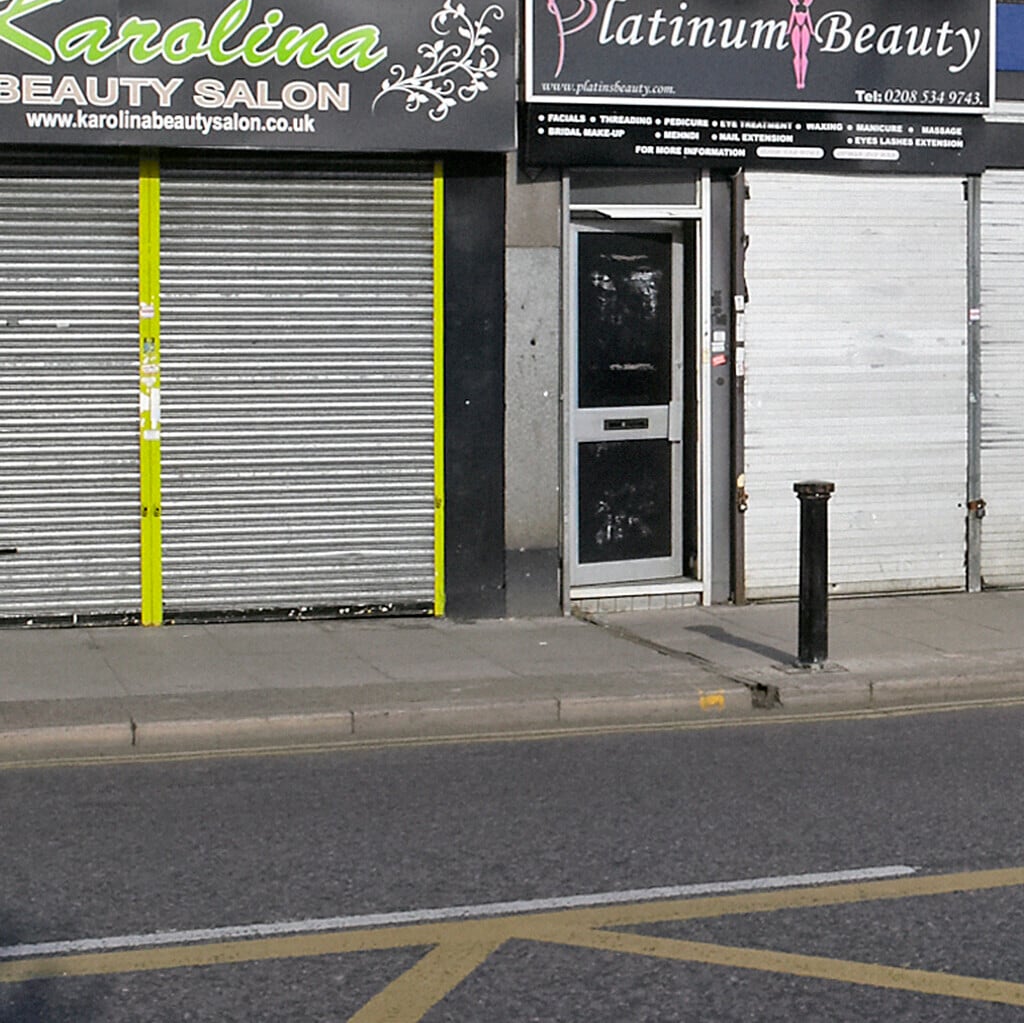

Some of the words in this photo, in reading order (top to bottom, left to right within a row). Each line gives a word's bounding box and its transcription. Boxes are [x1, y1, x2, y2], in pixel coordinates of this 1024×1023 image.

[815, 11, 982, 73] Beauty
[193, 80, 350, 111] SALON
[855, 89, 882, 103] Tel:
[884, 88, 918, 104] 0208
[920, 90, 945, 105] 534
[26, 110, 316, 135] www.karolinabeautysalon.co.uk
[547, 113, 587, 124] FACIALS
[599, 115, 652, 126] THREADING
[664, 118, 709, 128] PEDICURE
[806, 122, 844, 132] WAXING
[855, 123, 903, 134] MANICURE
[921, 126, 963, 136] MASSAGE
[547, 127, 582, 137] BRIDAL
[583, 129, 625, 139] MAKE-UP
[663, 130, 700, 141] MEHNDI
[719, 132, 740, 142] NAIL
[741, 133, 794, 144] EXTENSION
[854, 136, 878, 146] EYES
[879, 137, 913, 147] LASHES
[914, 139, 964, 149] EXTENSION
[635, 145, 655, 154] FOR
[655, 146, 682, 156] MORE
[683, 147, 746, 158] INFORMATION
